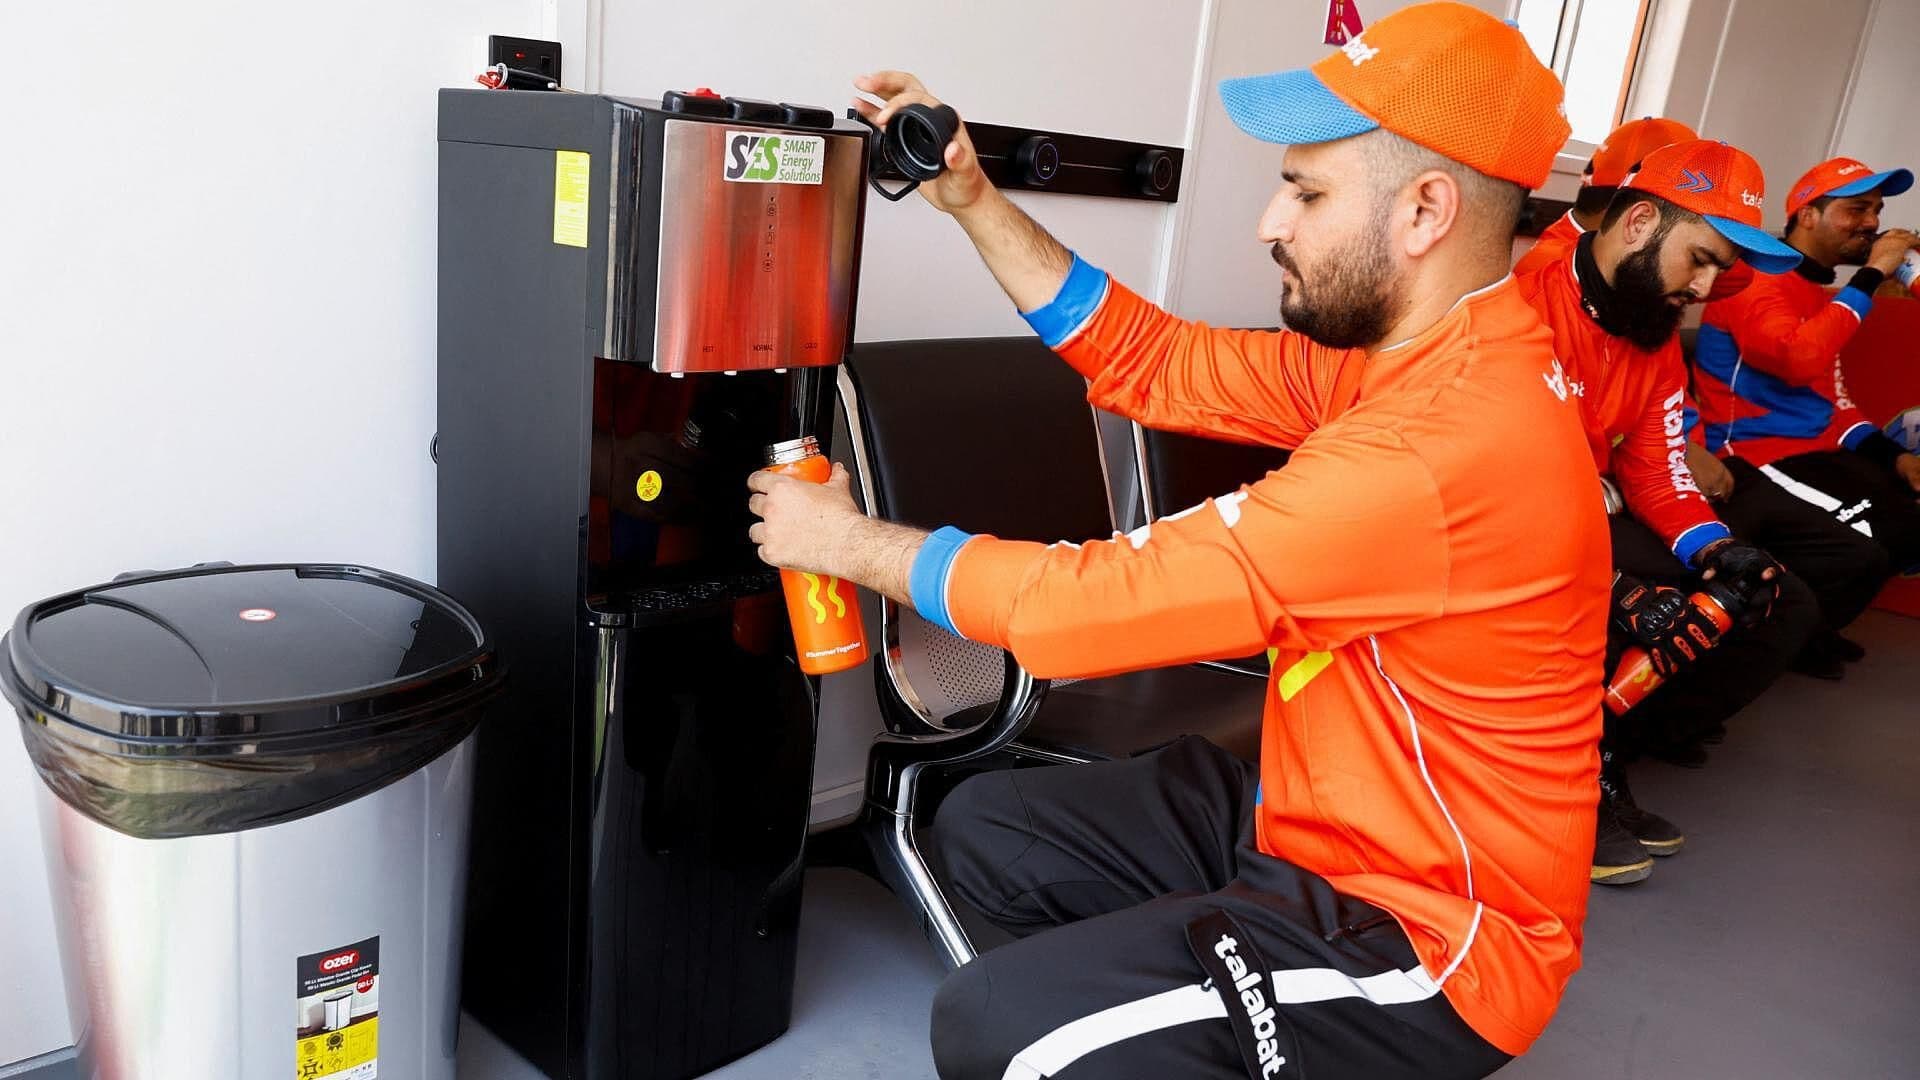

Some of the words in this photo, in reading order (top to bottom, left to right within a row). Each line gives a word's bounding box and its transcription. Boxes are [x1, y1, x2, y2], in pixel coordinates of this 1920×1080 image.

[783, 139, 817, 153] SMART
[781, 153, 814, 170] Energy
[778, 168, 821, 183] Solutions
[1214, 933, 1286, 1080] talabat
